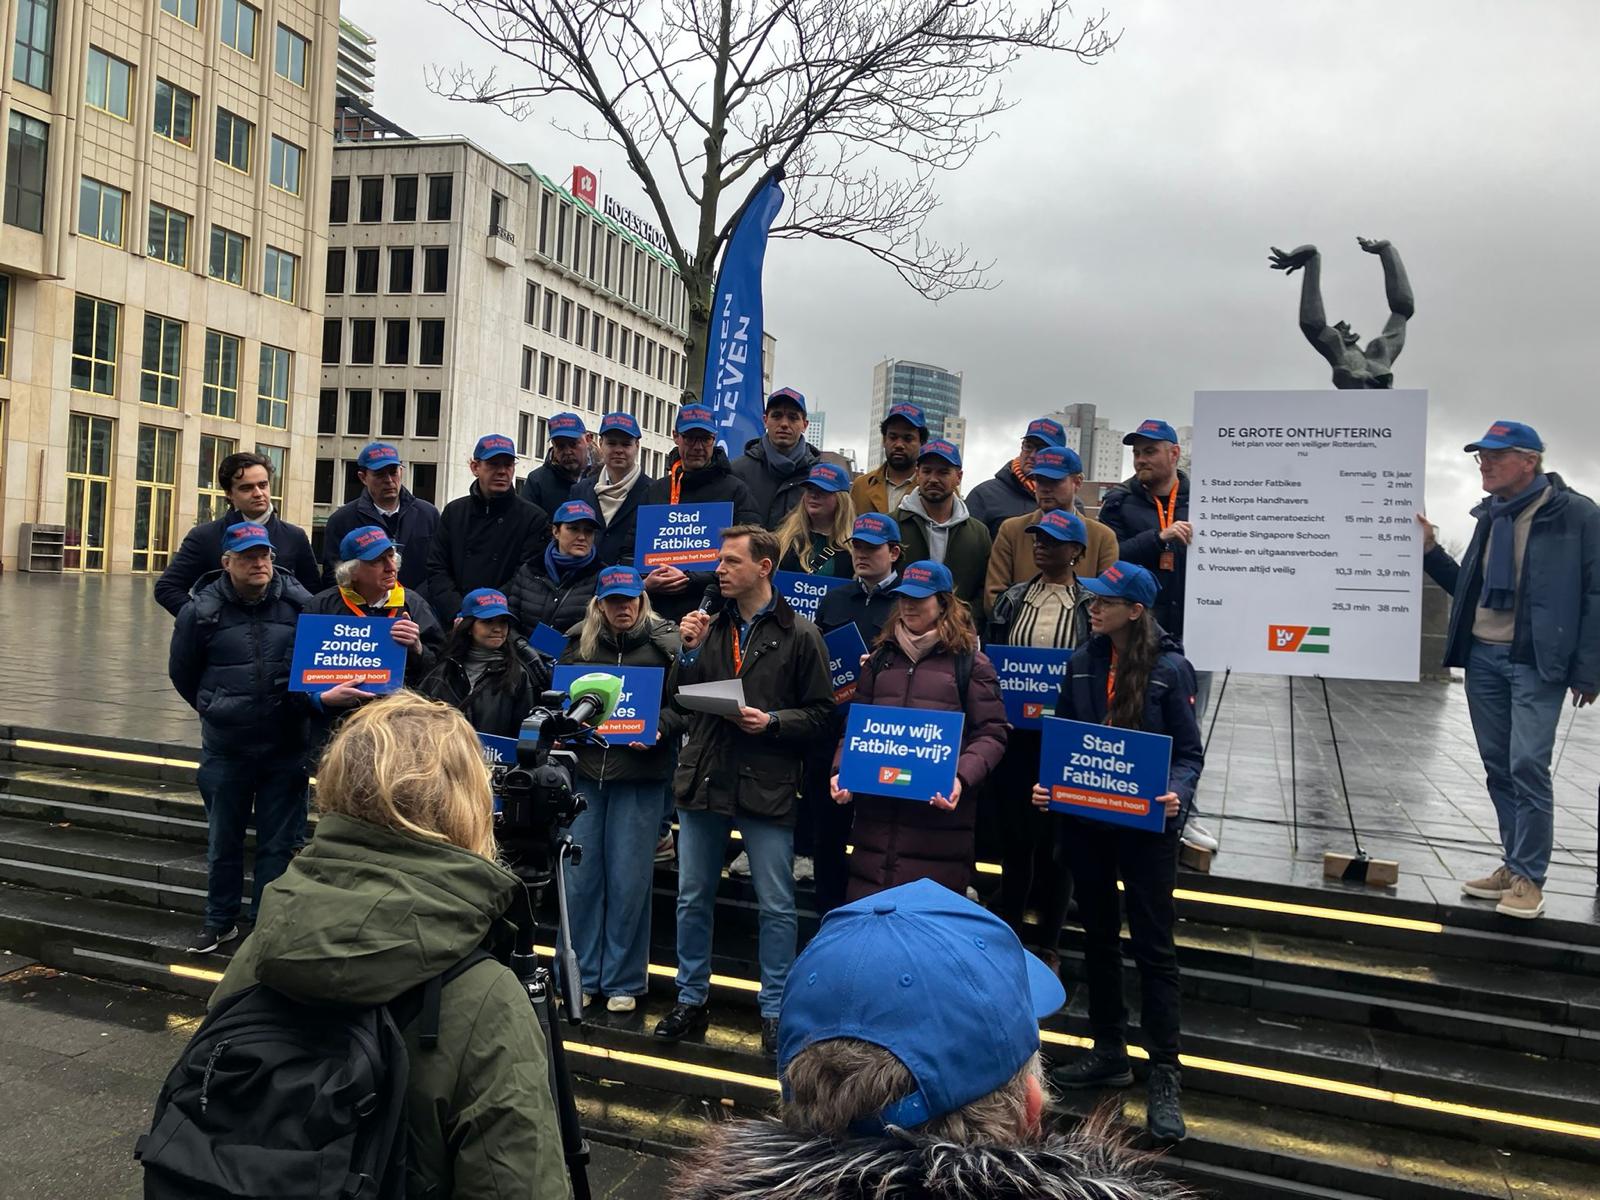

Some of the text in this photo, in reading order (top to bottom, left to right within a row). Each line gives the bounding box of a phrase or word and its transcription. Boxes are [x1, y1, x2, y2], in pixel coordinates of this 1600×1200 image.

[1218, 428, 1392, 438] DE GROTE ONTHUFTERING
[1246, 440, 1264, 449] plan
[1301, 441, 1330, 449] veiliger
[1339, 470, 1376, 478] Eenmalig
[1229, 496, 1254, 504] Korps
[668, 511, 700, 523] Stad
[1210, 513, 1254, 522] Intelligent
[659, 523, 707, 536] zonder
[1210, 530, 1248, 538] Operatie
[1249, 531, 1294, 539] Singapore
[653, 537, 711, 550] Fatbikes
[1258, 549, 1338, 557] uitgaansverboden
[1249, 565, 1270, 574] altijd
[1272, 566, 1296, 575] veilig
[794, 581, 827, 596] Stad
[784, 596, 820, 609] zond
[334, 624, 371, 638] Stad
[321, 639, 378, 652] zonder
[314, 653, 382, 667] Fatbikes
[1002, 659, 1067, 675] Jouw wi
[997, 676, 1061, 693] atbike-
[863, 719, 943, 742] Jouw wijk
[850, 736, 952, 764] Fatbike-vrij?
[1082, 734, 1125, 756] Stad
[484, 747, 503, 762] ijk
[1070, 752, 1134, 774] zonder
[1063, 766, 1139, 795] Fatbikes
